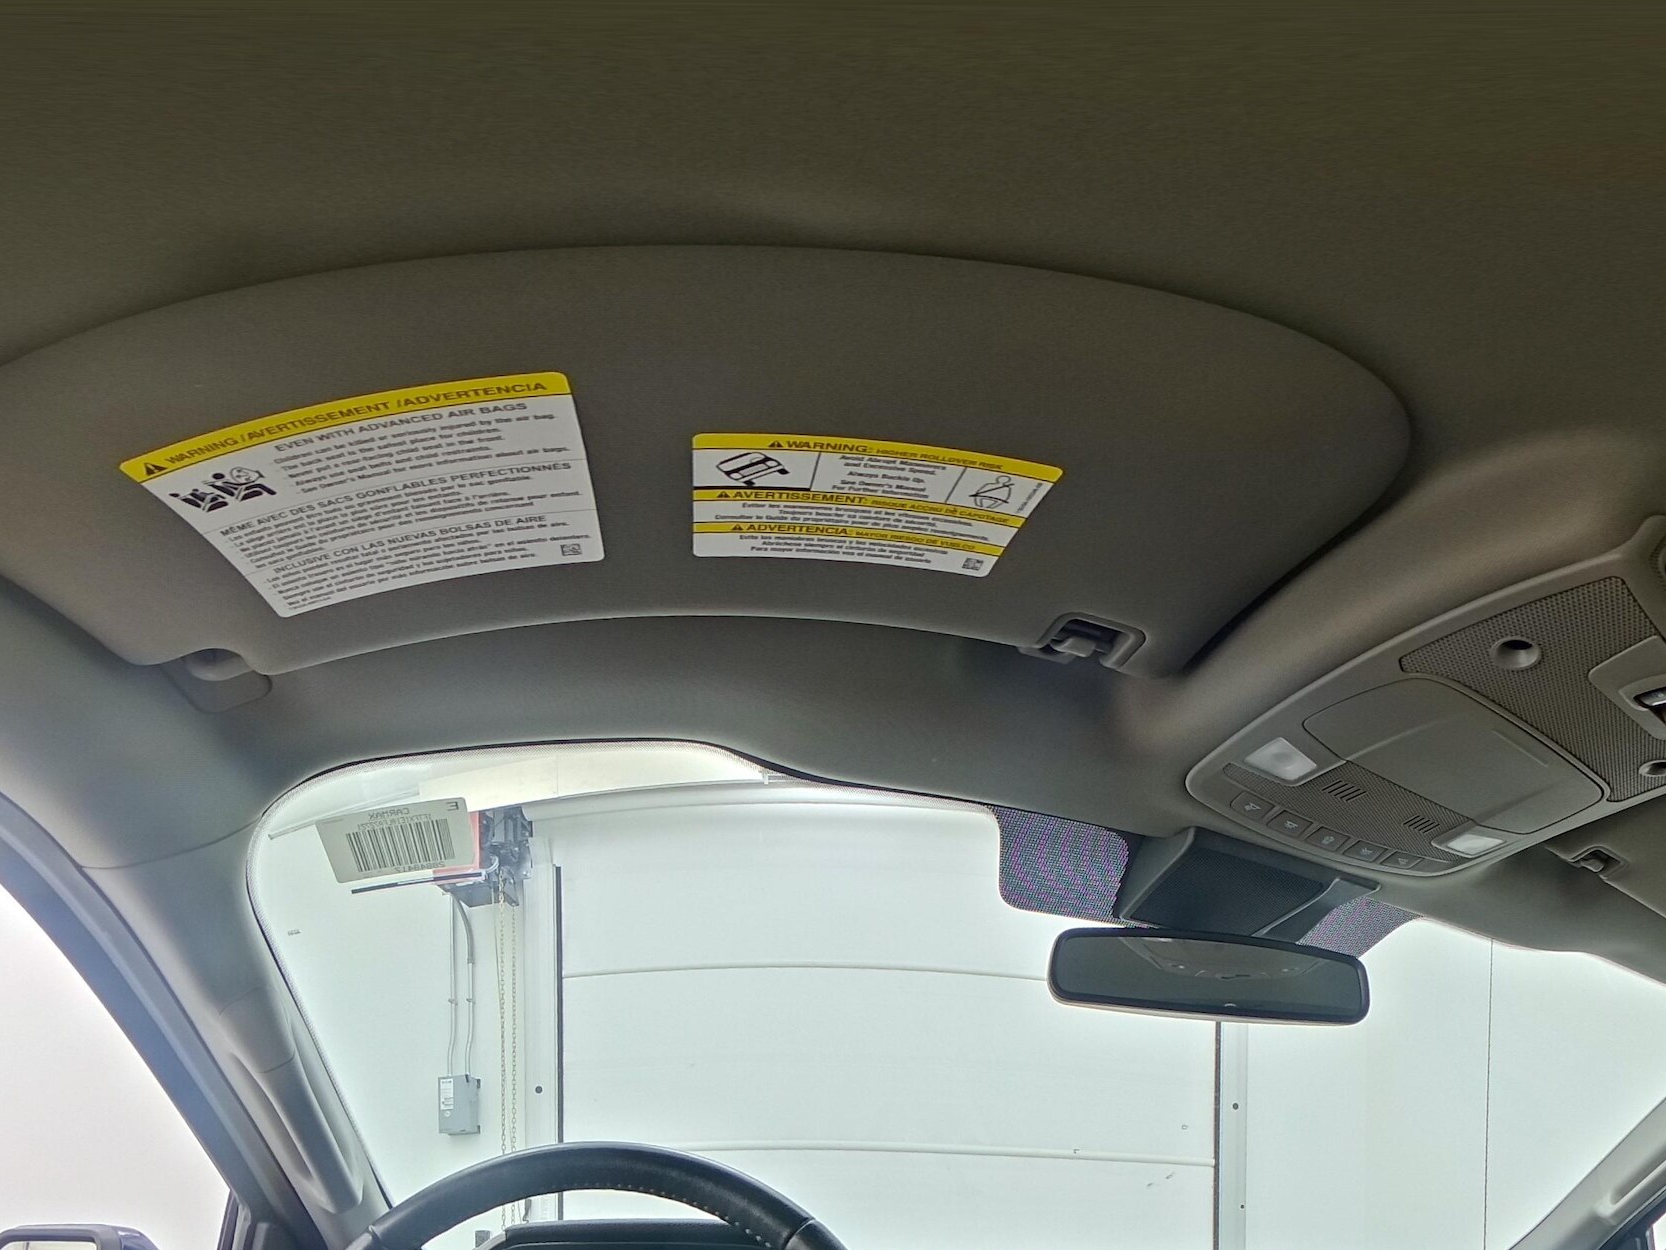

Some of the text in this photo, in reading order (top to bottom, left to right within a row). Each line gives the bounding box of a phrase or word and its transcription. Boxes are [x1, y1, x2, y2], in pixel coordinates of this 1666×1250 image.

[165, 437, 239, 464] WARNING
[274, 403, 528, 452] EVEN WITH ADVANCED AIR BAGS
[220, 521, 255, 537] MÊME
[257, 512, 289, 526] AVEC
[289, 504, 316, 516] DES
[317, 496, 354, 509] SACS
[356, 476, 447, 499] GONFLABLES
[273, 515, 547, 574] INCLUSIVE CON LAS NUEVAS BOLSAS DE AIRE
